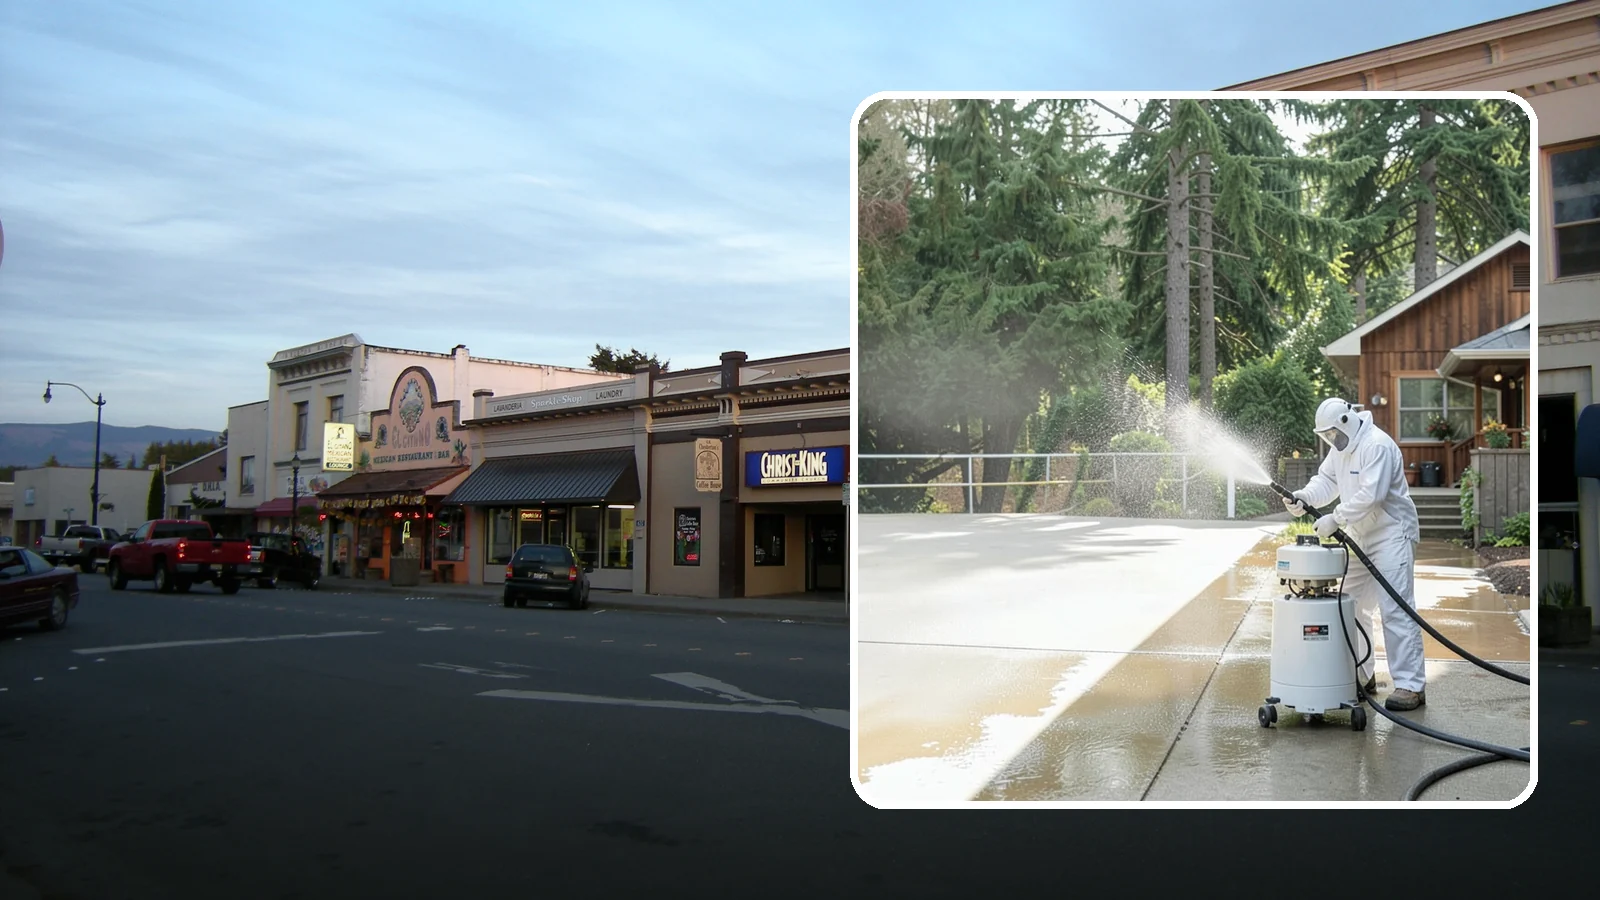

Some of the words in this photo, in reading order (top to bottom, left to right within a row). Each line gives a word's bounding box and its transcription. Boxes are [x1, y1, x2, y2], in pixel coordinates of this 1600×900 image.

[595, 389, 623, 400] LAUNDRY
[494, 402, 522, 412] LAVANDERIA
[530, 396, 560, 408] Sparkle
[562, 395, 582, 406] Shop
[373, 455, 396, 464] MEXICAN
[397, 451, 434, 462] RESTAURANT
[437, 450, 450, 459] BAR
[760, 452, 797, 478] CHRIST
[799, 450, 827, 476] KING
